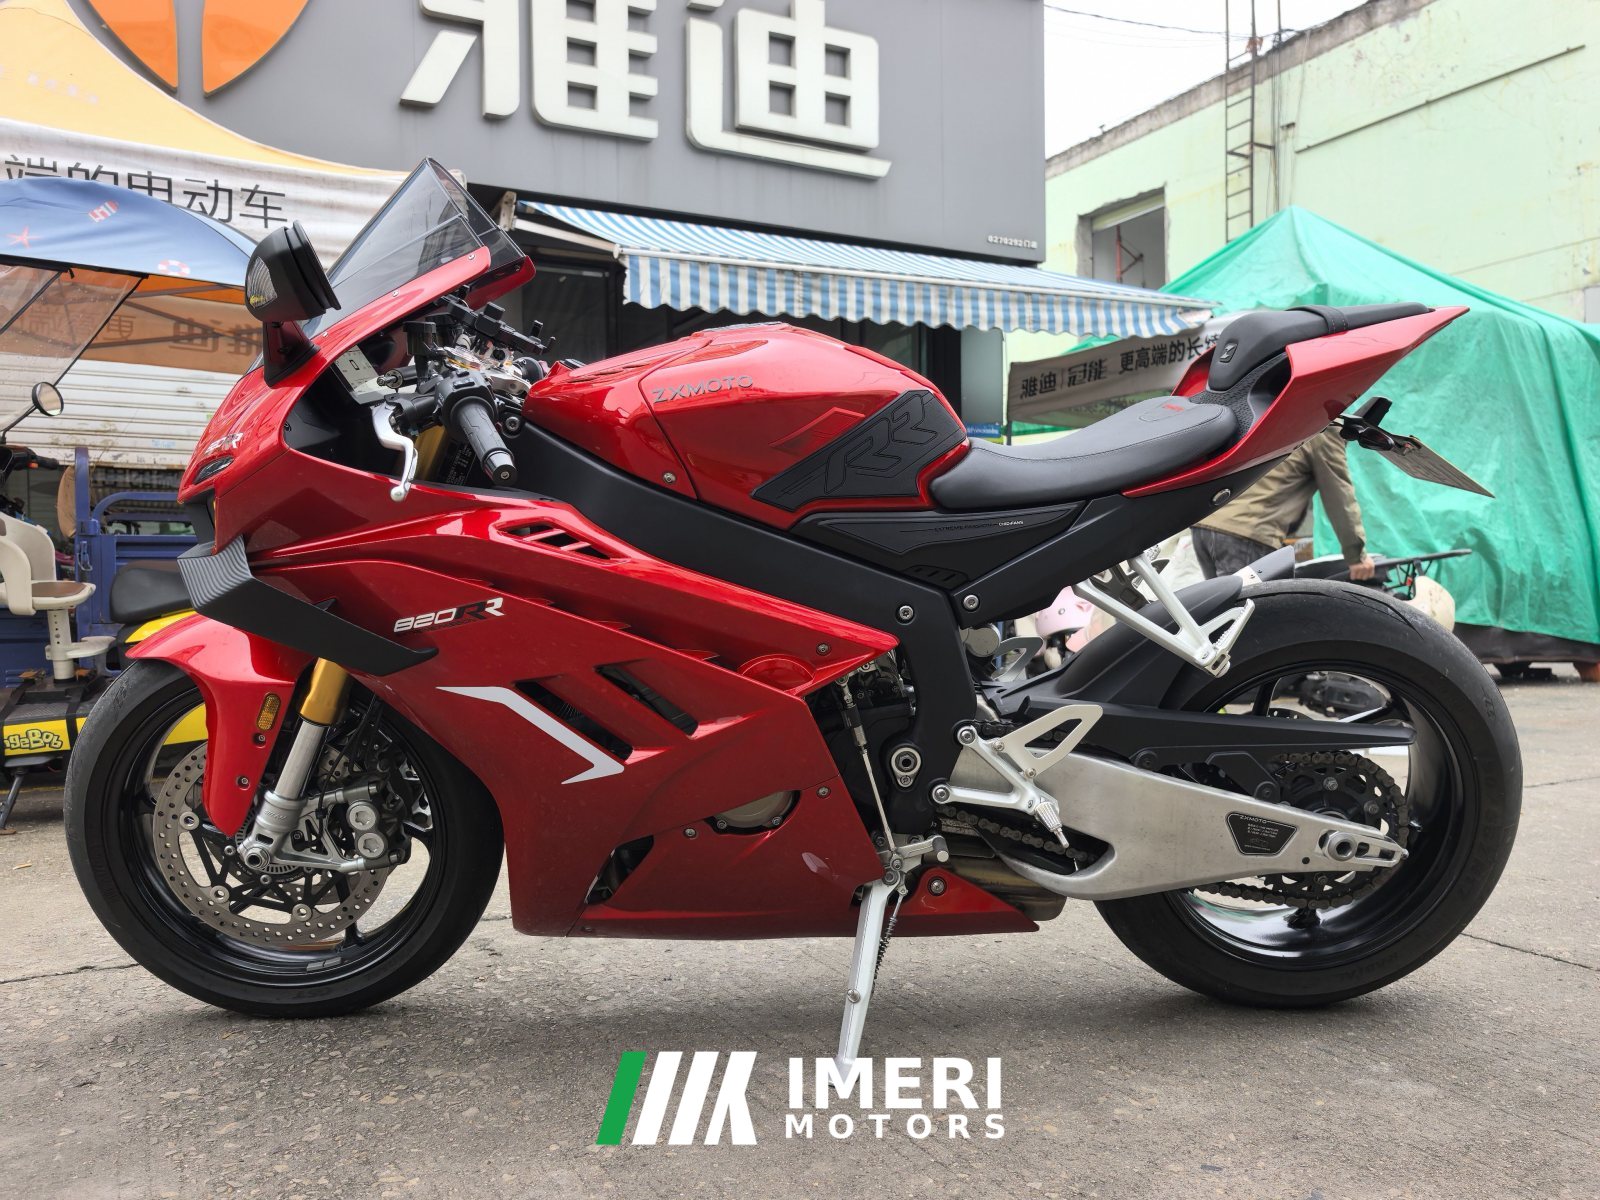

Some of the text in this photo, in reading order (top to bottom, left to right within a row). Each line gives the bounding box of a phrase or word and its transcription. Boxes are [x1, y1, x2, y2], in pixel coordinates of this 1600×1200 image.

[652, 375, 754, 404] ZXMOTO
[1020, 371, 1057, 399] 雅迪
[394, 597, 505, 632] 820RR
[1239, 815, 1268, 824] ZXMOTO
